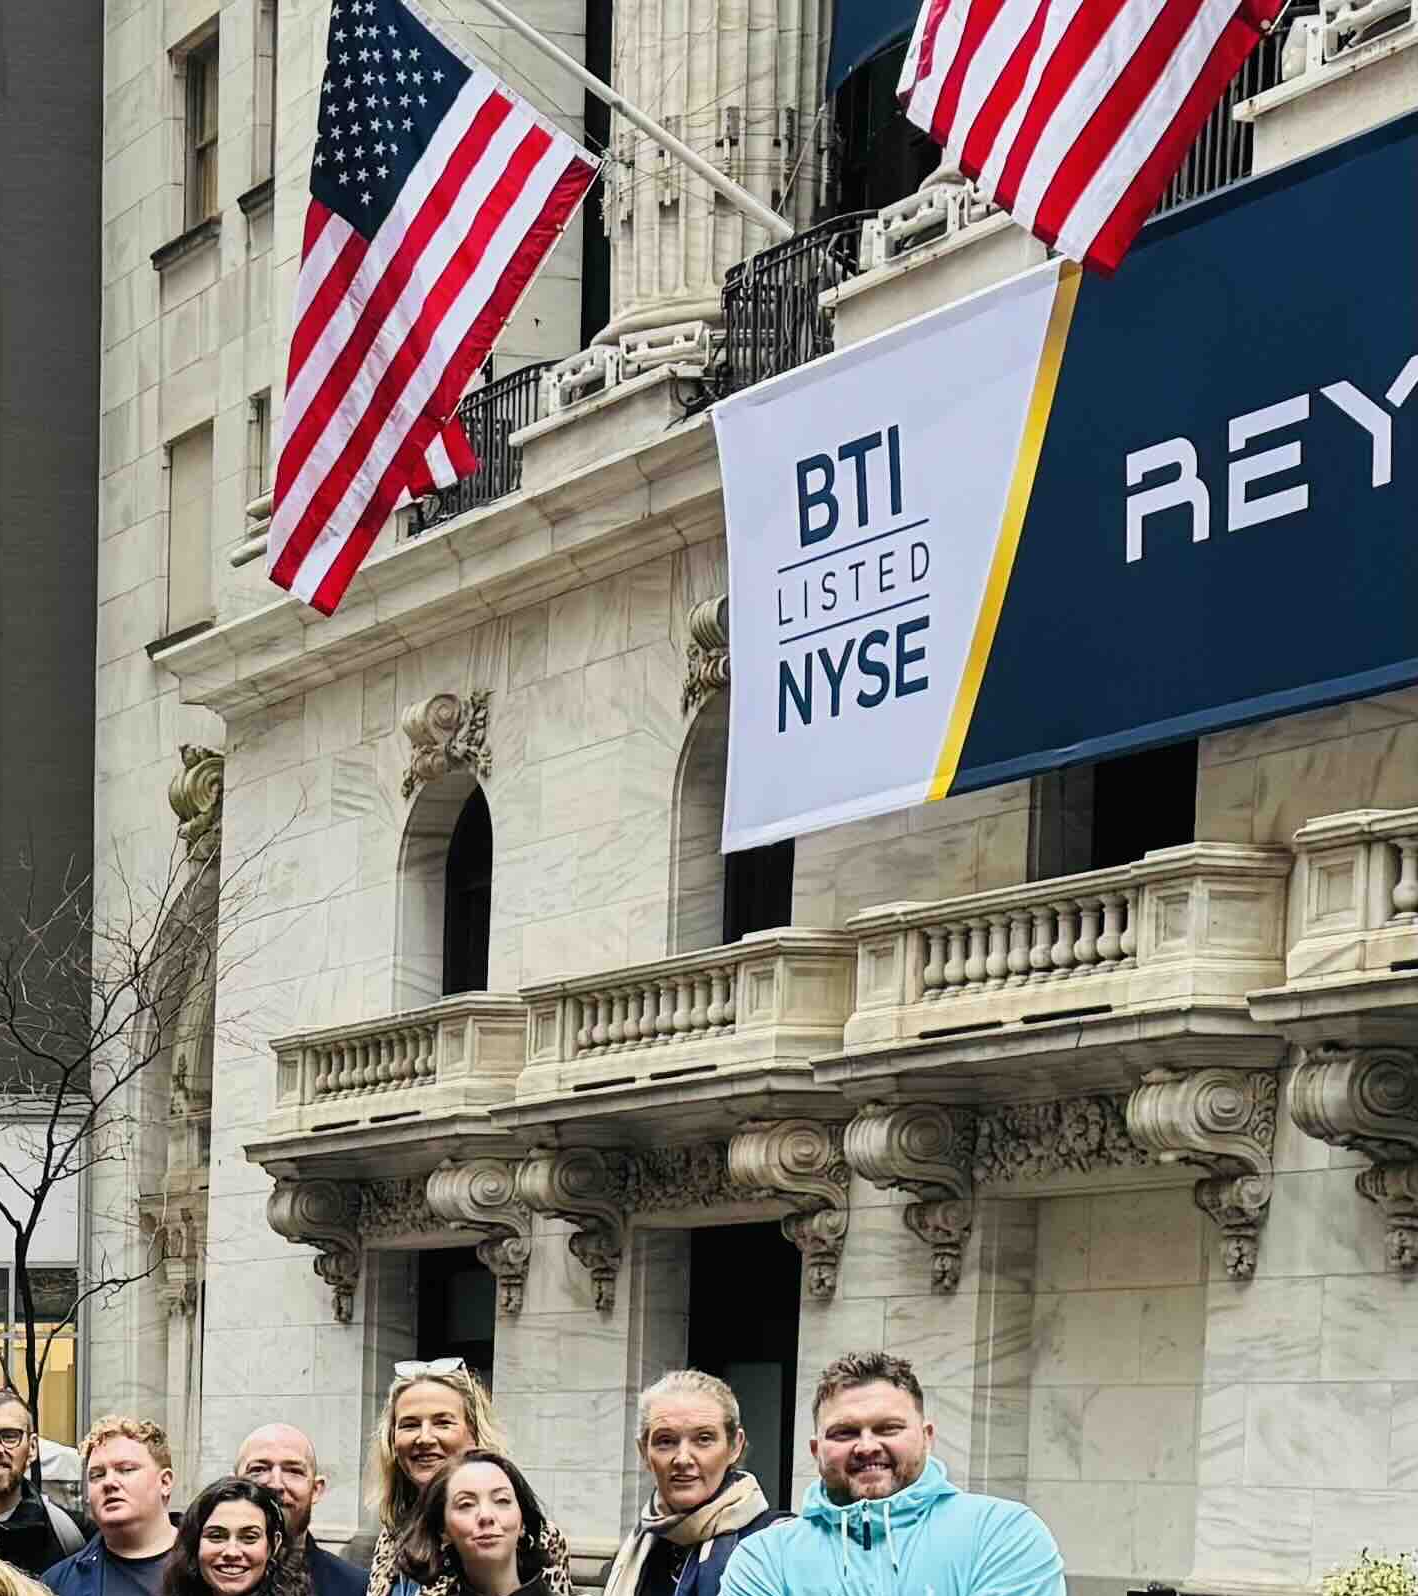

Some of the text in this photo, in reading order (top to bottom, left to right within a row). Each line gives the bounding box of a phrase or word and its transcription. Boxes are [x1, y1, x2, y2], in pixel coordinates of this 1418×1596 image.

[796, 424, 903, 548] BTI
[777, 541, 930, 626] LISTED
[777, 615, 930, 733] NYSE
